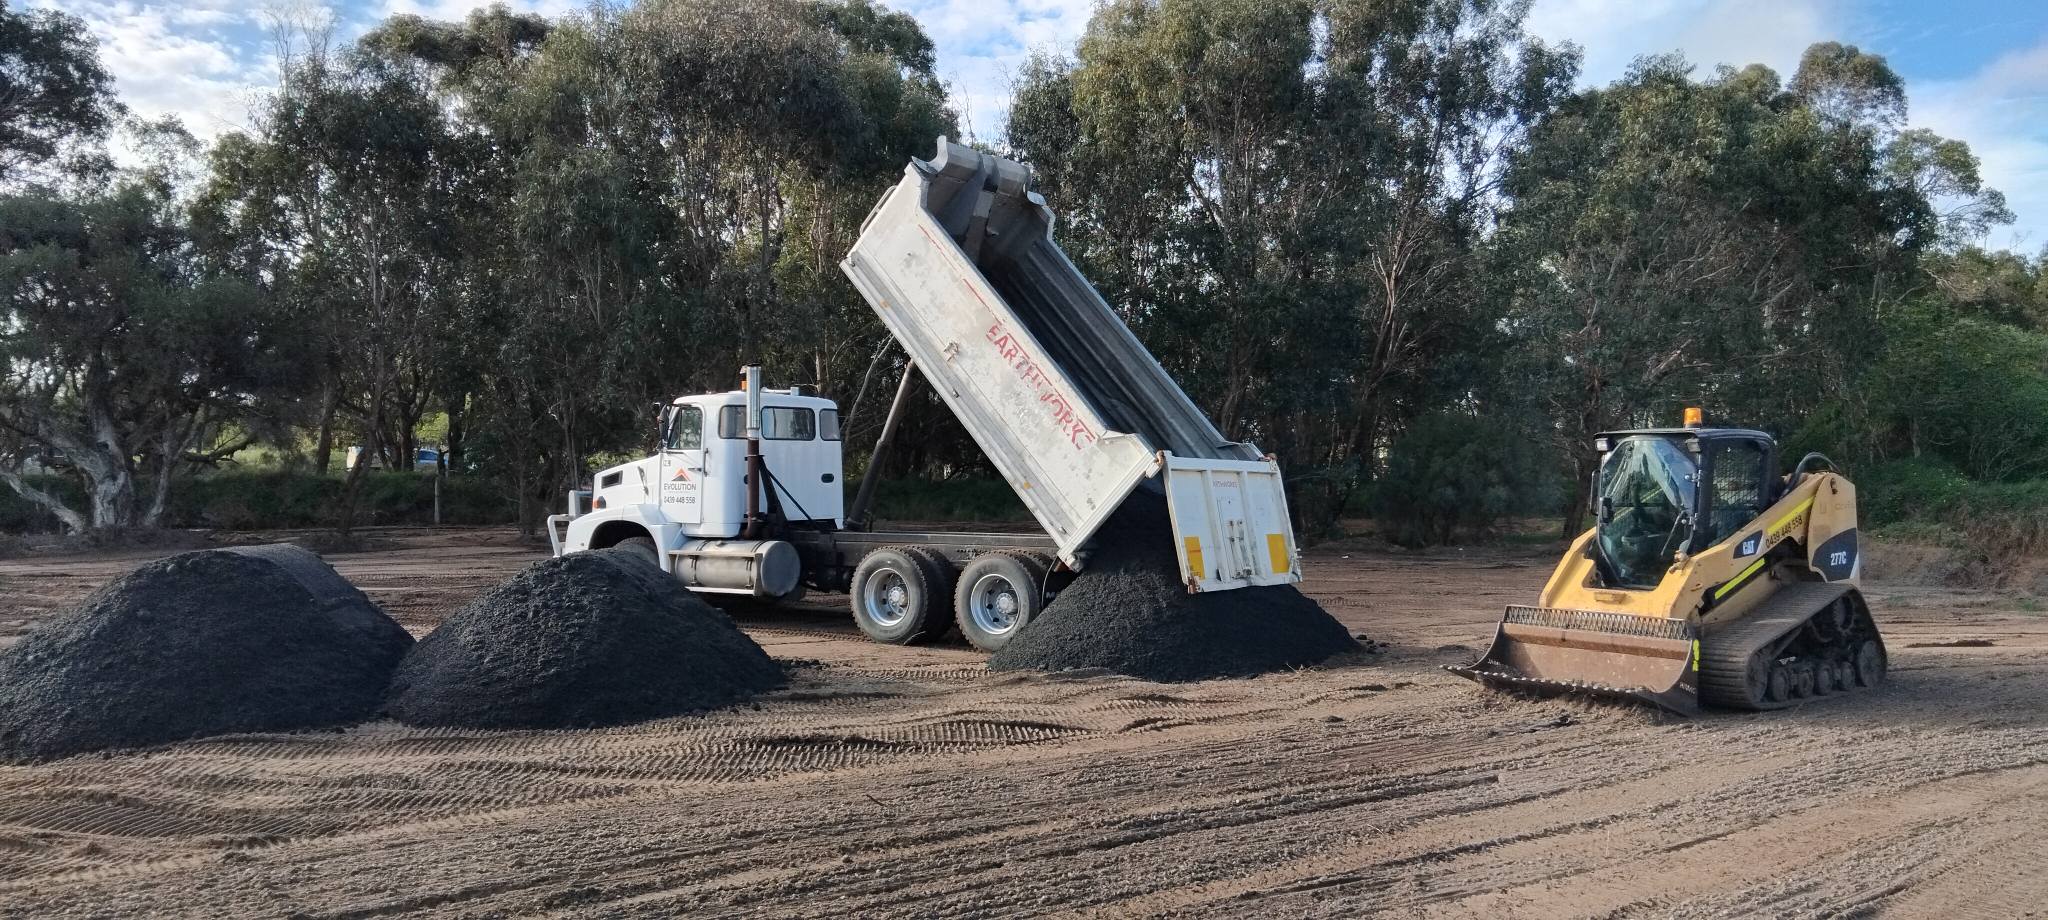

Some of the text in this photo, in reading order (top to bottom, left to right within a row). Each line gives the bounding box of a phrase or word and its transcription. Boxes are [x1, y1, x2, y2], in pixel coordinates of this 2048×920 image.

[663, 483, 697, 491] EVOLUTION
[663, 496, 696, 504] 0439 448 558
[1765, 515, 1803, 549] 0439 448 558
[1742, 540, 1755, 555] CAT
[1830, 551, 1847, 566] 277C
